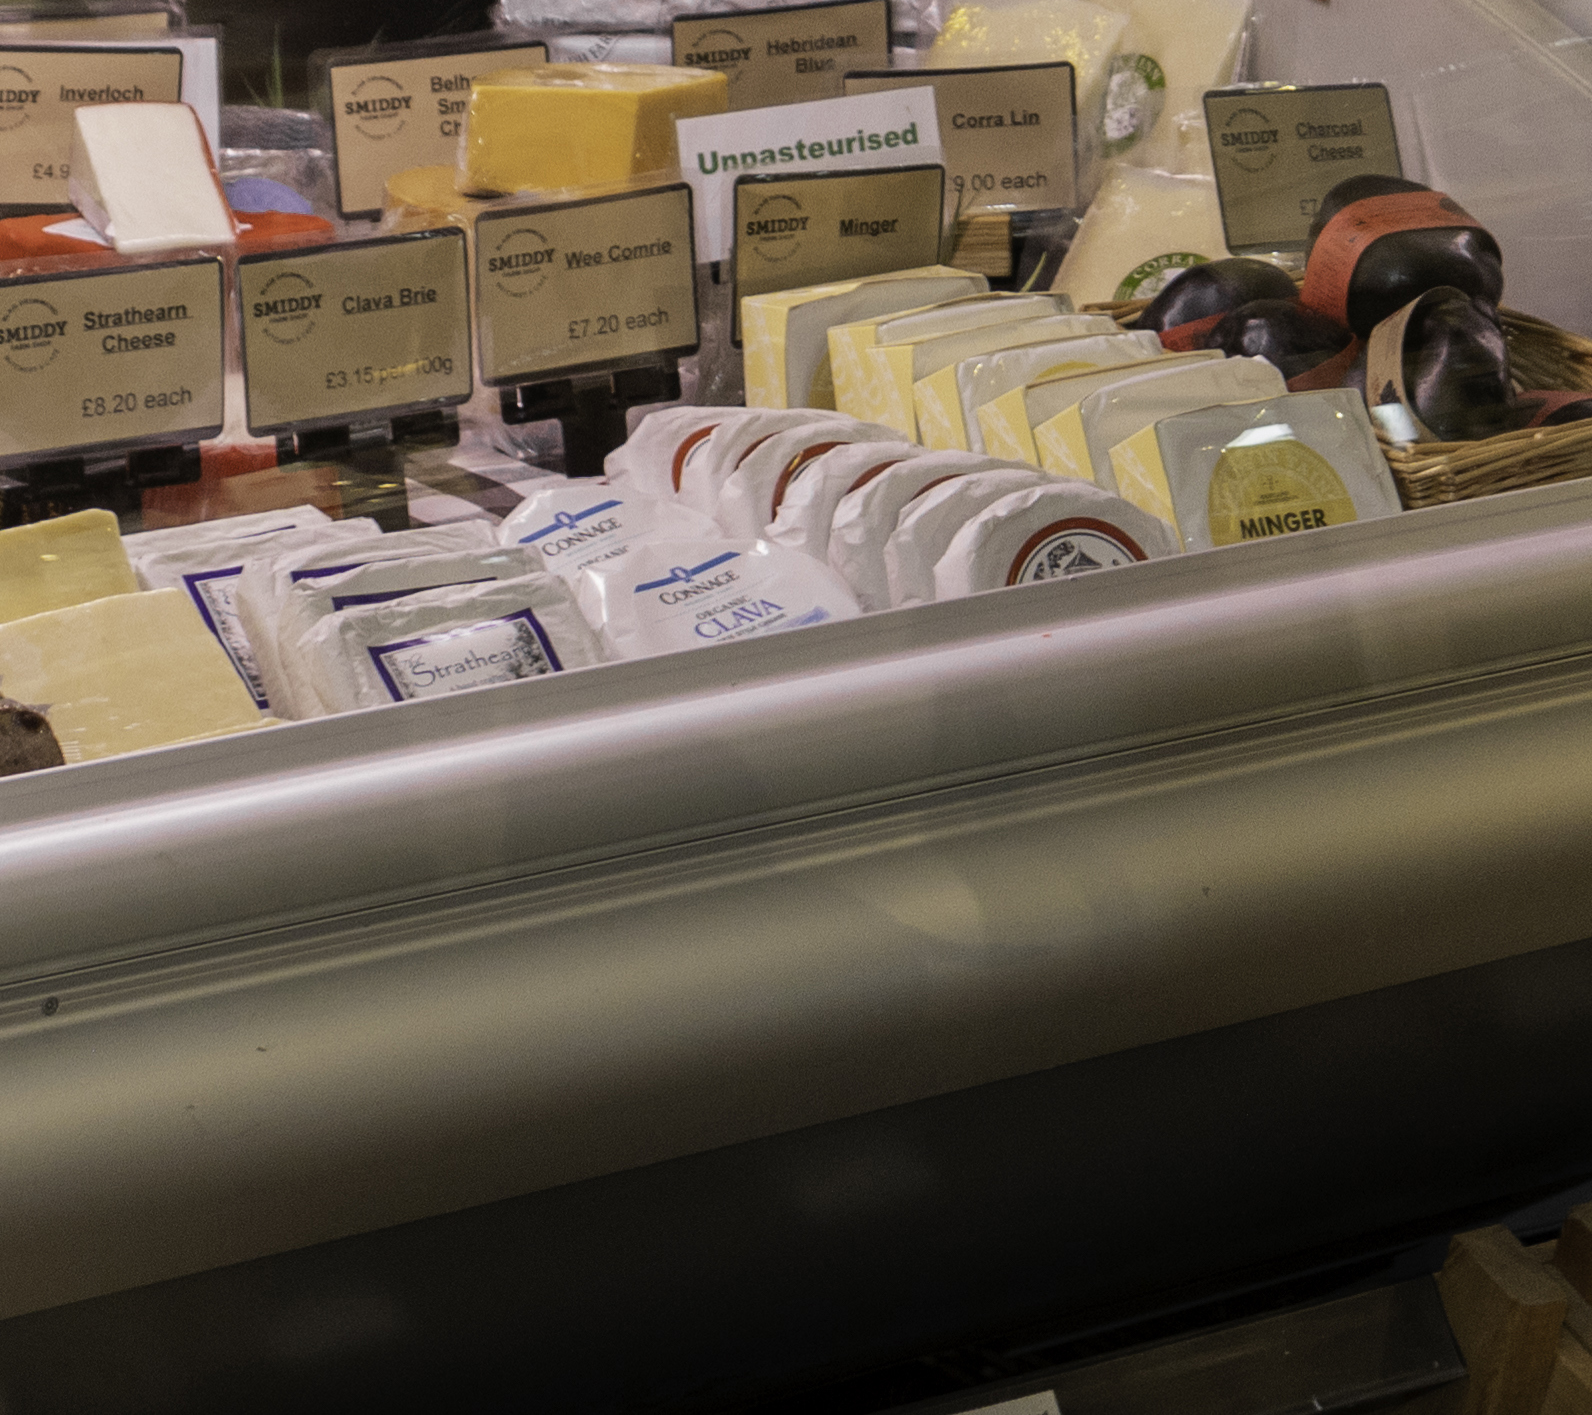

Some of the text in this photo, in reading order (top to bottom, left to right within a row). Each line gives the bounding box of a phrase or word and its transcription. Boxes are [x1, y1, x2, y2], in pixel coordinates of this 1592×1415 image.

[684, 34, 858, 67] SMIDDY Hebridean
[60, 84, 144, 102] Inverloch
[345, 96, 412, 115] SMIDDY
[952, 110, 1040, 130] Corra Lin
[1221, 119, 1363, 148] SMIDDY Charcoal
[697, 122, 920, 176] Unpasteurised
[1309, 144, 1364, 162] Cheese
[1000, 172, 1048, 190] each
[746, 217, 899, 238] SMIDDY Minger
[488, 239, 672, 272] SMIDDY Wee Comrie
[83, 303, 188, 332] Strathearn
[253, 286, 437, 318] SMIDDY Clava Brie
[569, 307, 670, 339] £7.20 each
[102, 330, 177, 355] Cheese
[326, 366, 375, 390] £3.15
[415, 355, 454, 376] 100g
[82, 386, 193, 418] £8.20 each
[541, 517, 622, 557] CONNAGE
[1240, 508, 1327, 540] MINGER
[659, 570, 740, 607] CONNAGE
[694, 599, 785, 641] CLAVA
[695, 595, 753, 620] ORGANIC
